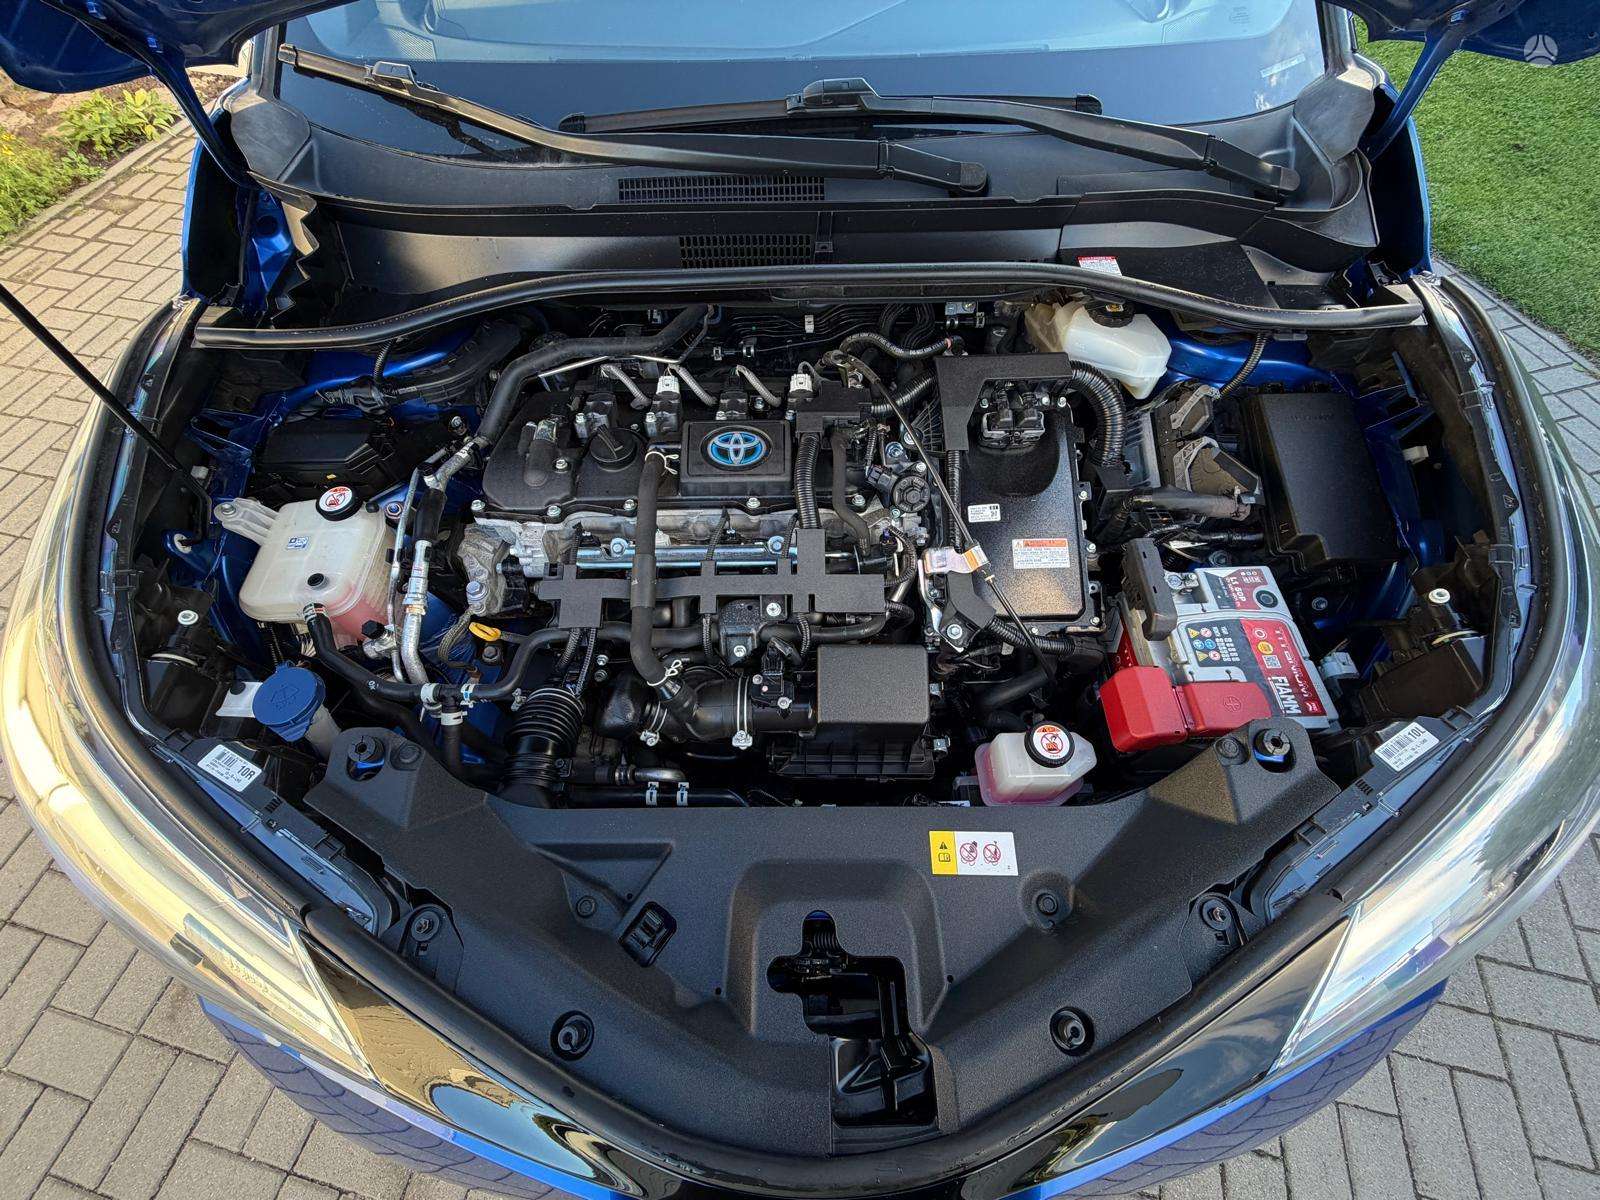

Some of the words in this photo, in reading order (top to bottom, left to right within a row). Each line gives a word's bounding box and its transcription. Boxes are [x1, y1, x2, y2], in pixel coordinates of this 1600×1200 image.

[1271, 676, 1302, 714] FIAMM
[1407, 726, 1426, 740] 10L
[237, 765, 256, 780] 10R
